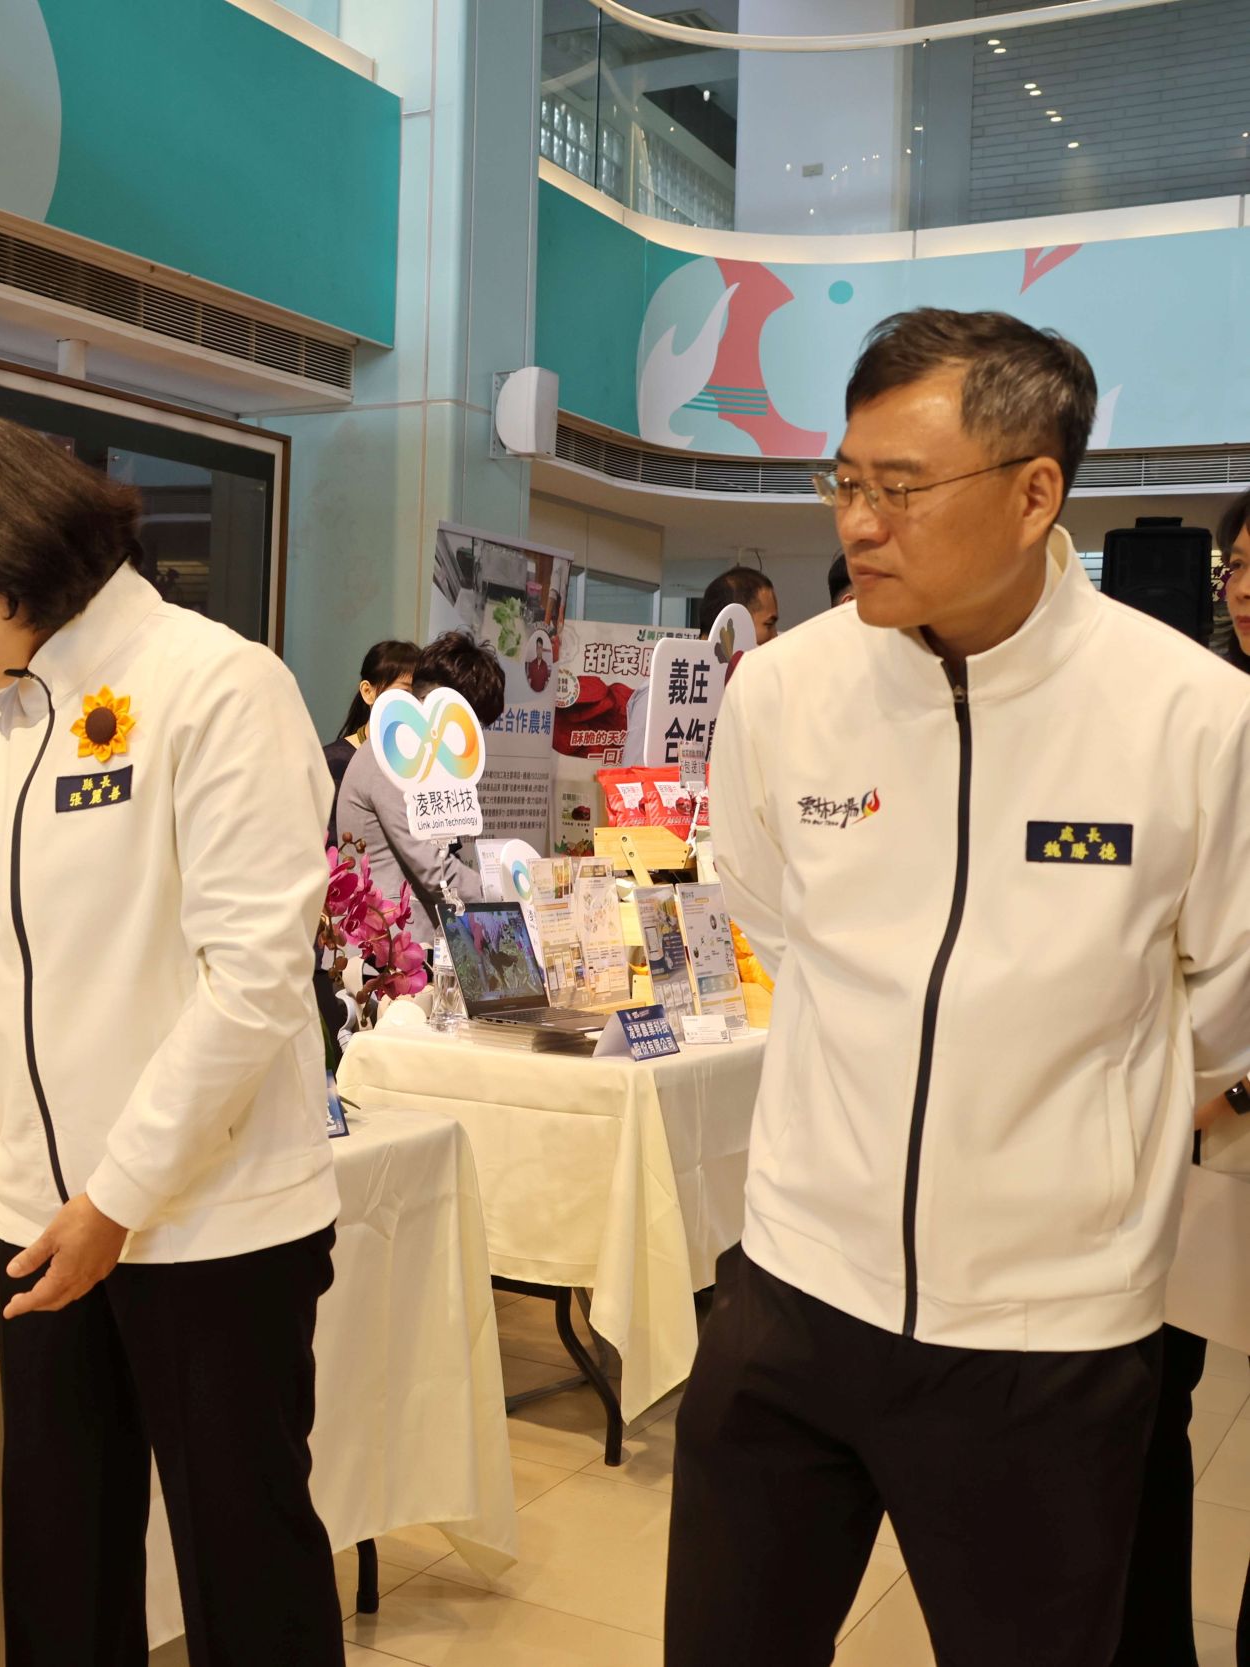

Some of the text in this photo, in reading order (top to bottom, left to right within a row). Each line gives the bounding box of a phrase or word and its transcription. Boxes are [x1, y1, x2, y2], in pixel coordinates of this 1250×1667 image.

[668, 658, 711, 704] 義庄
[482, 706, 551, 736] 庄合作農場
[413, 787, 476, 817] 凌聚科技
[417, 816, 478, 831] Link Join Technology
